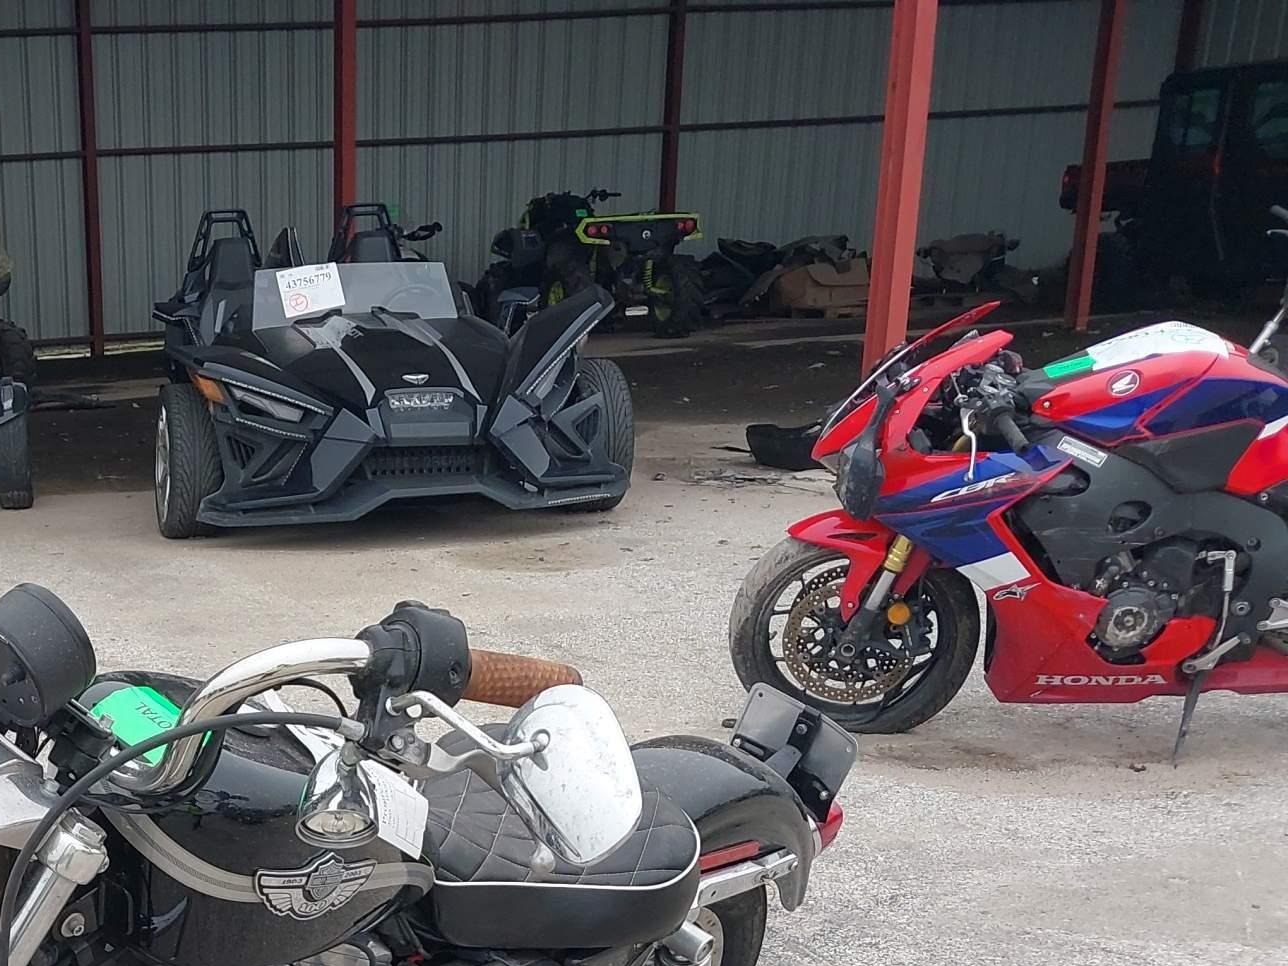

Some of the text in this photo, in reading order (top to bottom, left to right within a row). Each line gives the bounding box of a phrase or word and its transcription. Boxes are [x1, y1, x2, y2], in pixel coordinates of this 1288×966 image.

[285, 272, 331, 289] 43756779
[1034, 674, 1168, 686] HONDA
[135, 701, 173, 729] OTAL
